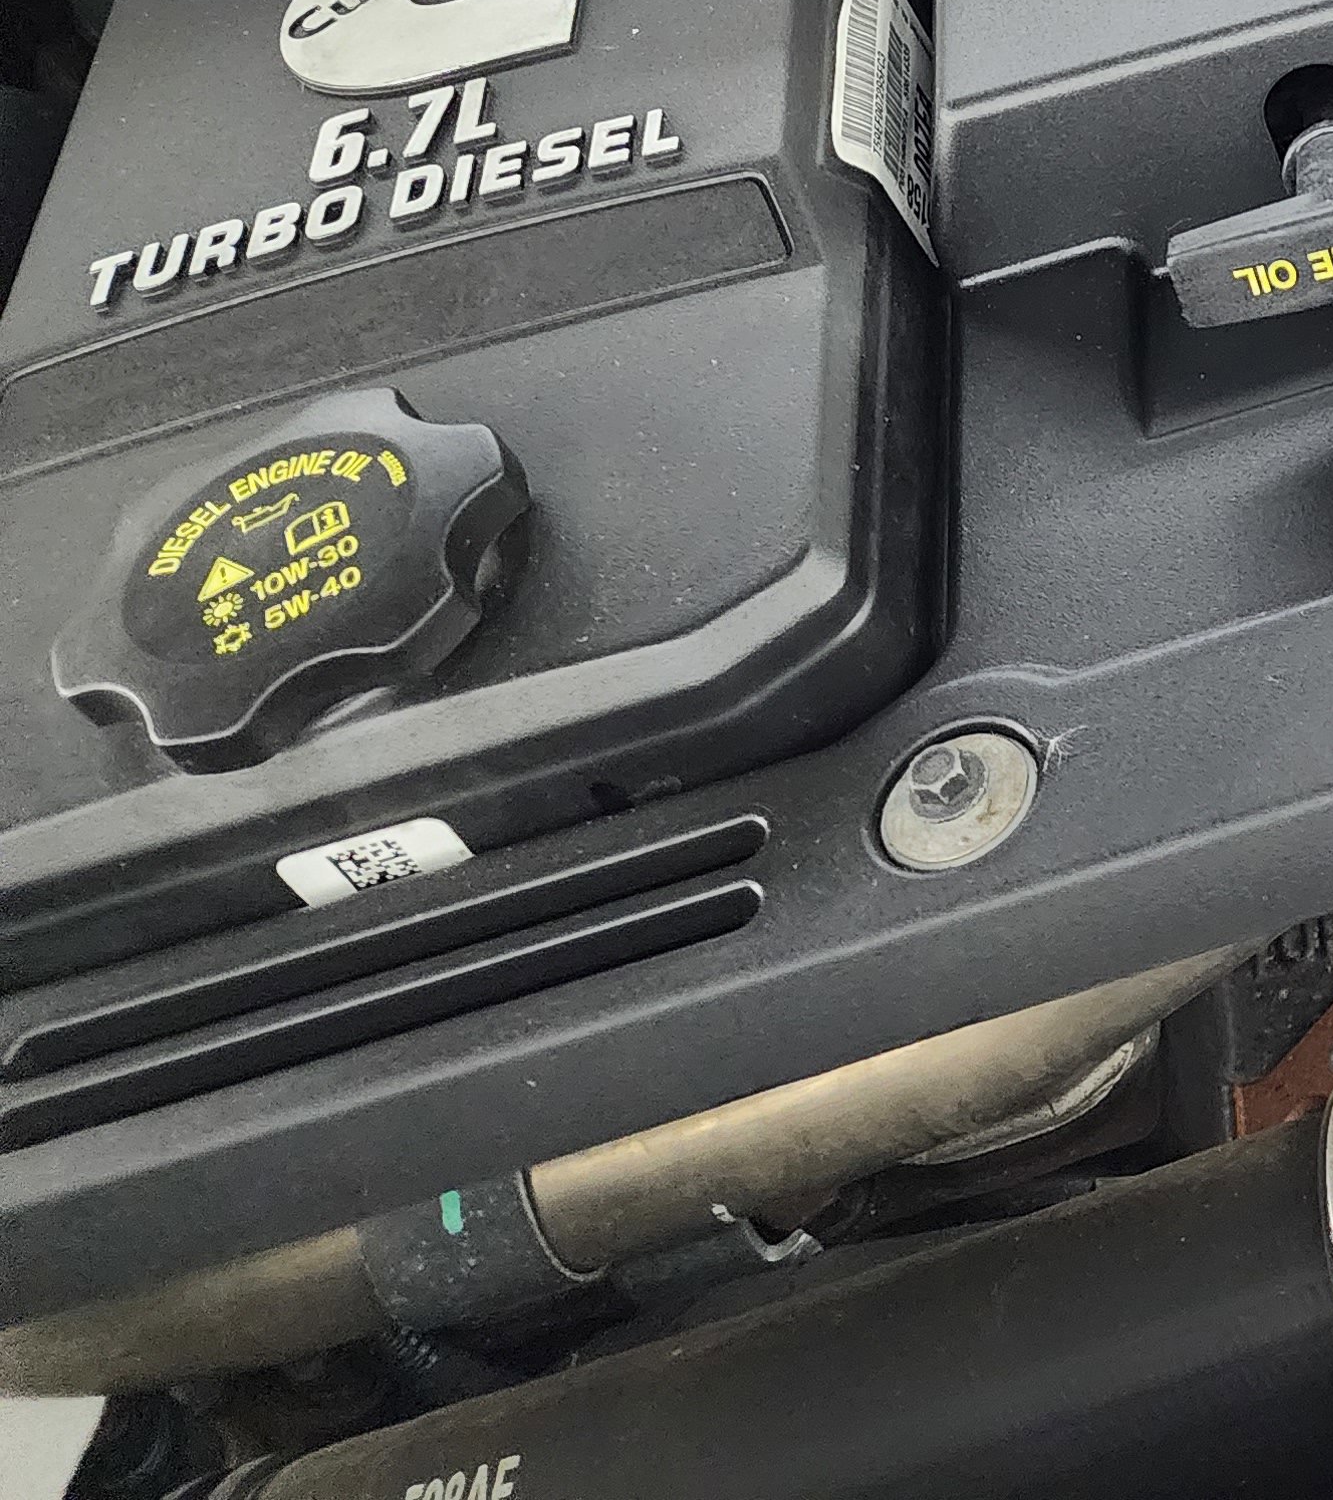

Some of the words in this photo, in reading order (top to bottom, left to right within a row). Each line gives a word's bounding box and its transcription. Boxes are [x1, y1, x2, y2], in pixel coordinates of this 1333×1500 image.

[308, 77, 497, 187] 6.7L
[88, 184, 367, 312] TURBO
[389, 107, 683, 221] DIESEL
[1232, 258, 1298, 297] OIL
[147, 499, 232, 577] DIESEL
[228, 449, 332, 503] ENGINE
[331, 450, 374, 483] OIL
[250, 534, 361, 601] 10W-30
[263, 566, 363, 630] 5W-40
